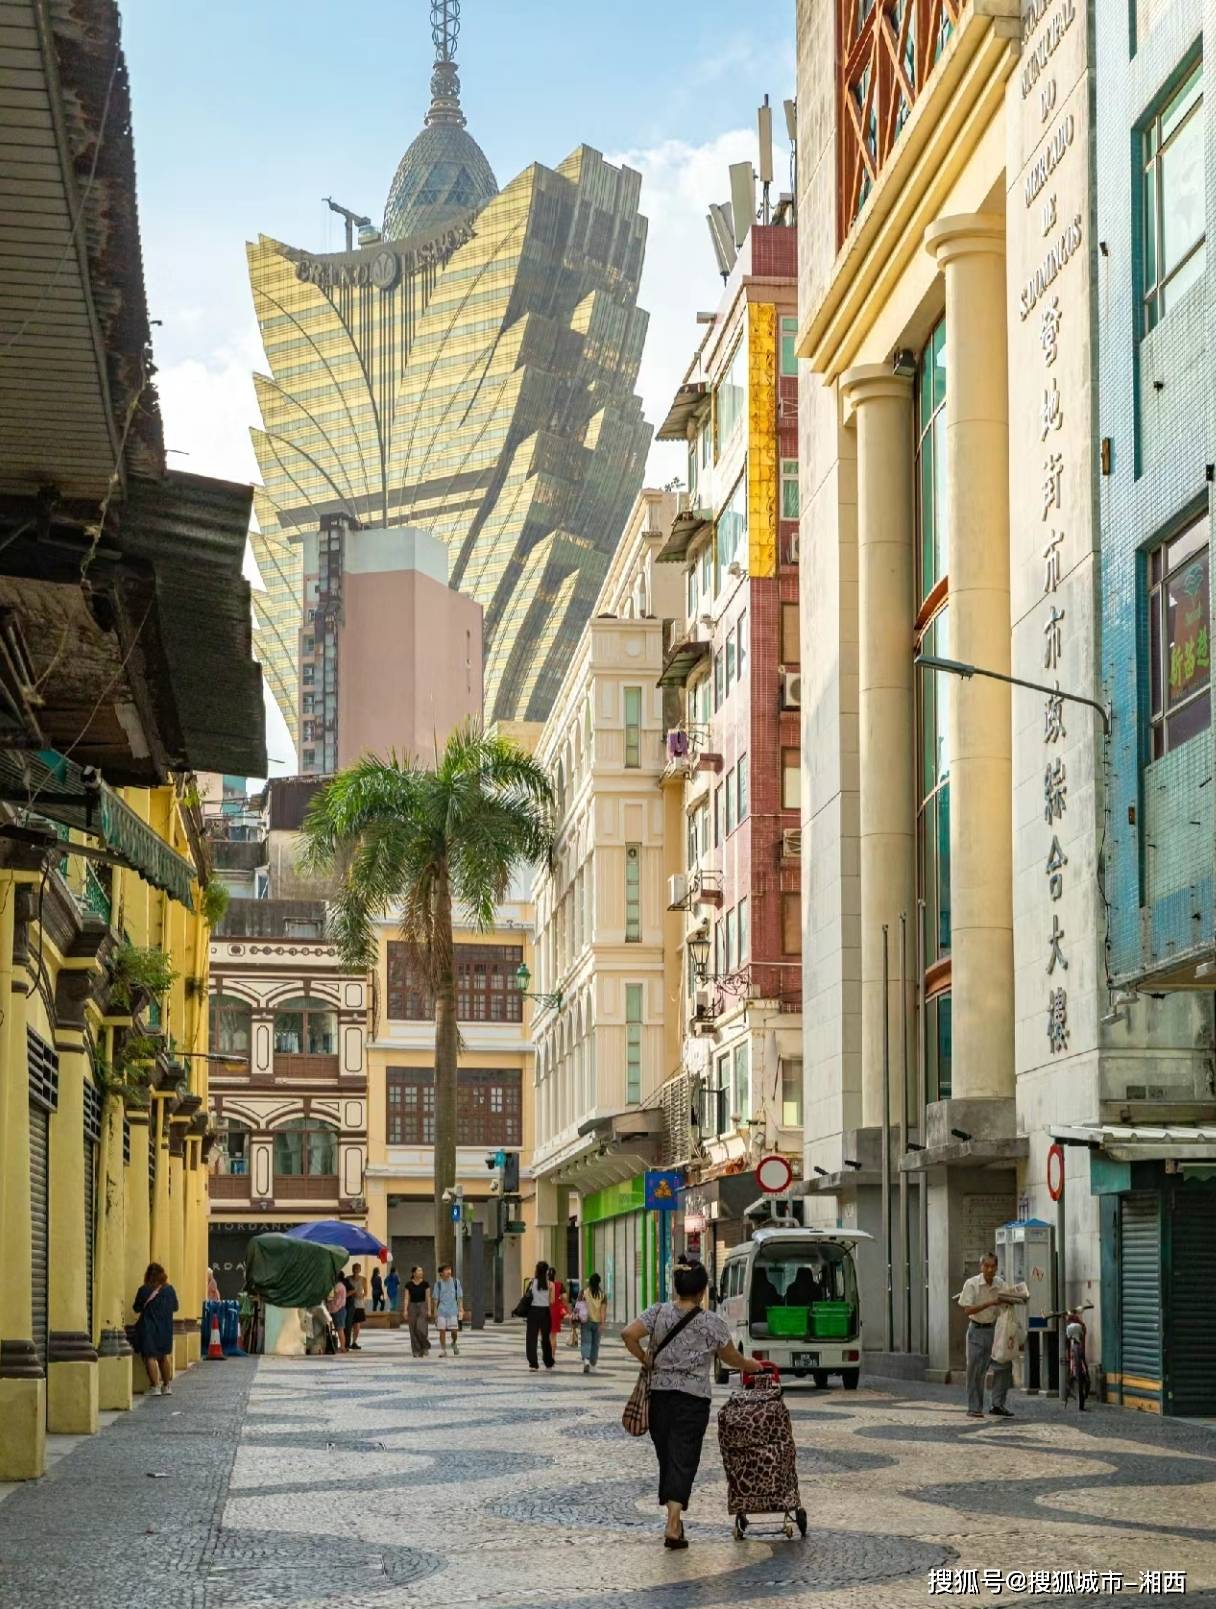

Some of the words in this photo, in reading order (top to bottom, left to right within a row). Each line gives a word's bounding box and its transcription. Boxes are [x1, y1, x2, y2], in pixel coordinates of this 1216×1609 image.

[1025, 114, 1075, 208] MERCADO
[295, 258, 372, 288] GRAND
[401, 220, 479, 275] LISBOA
